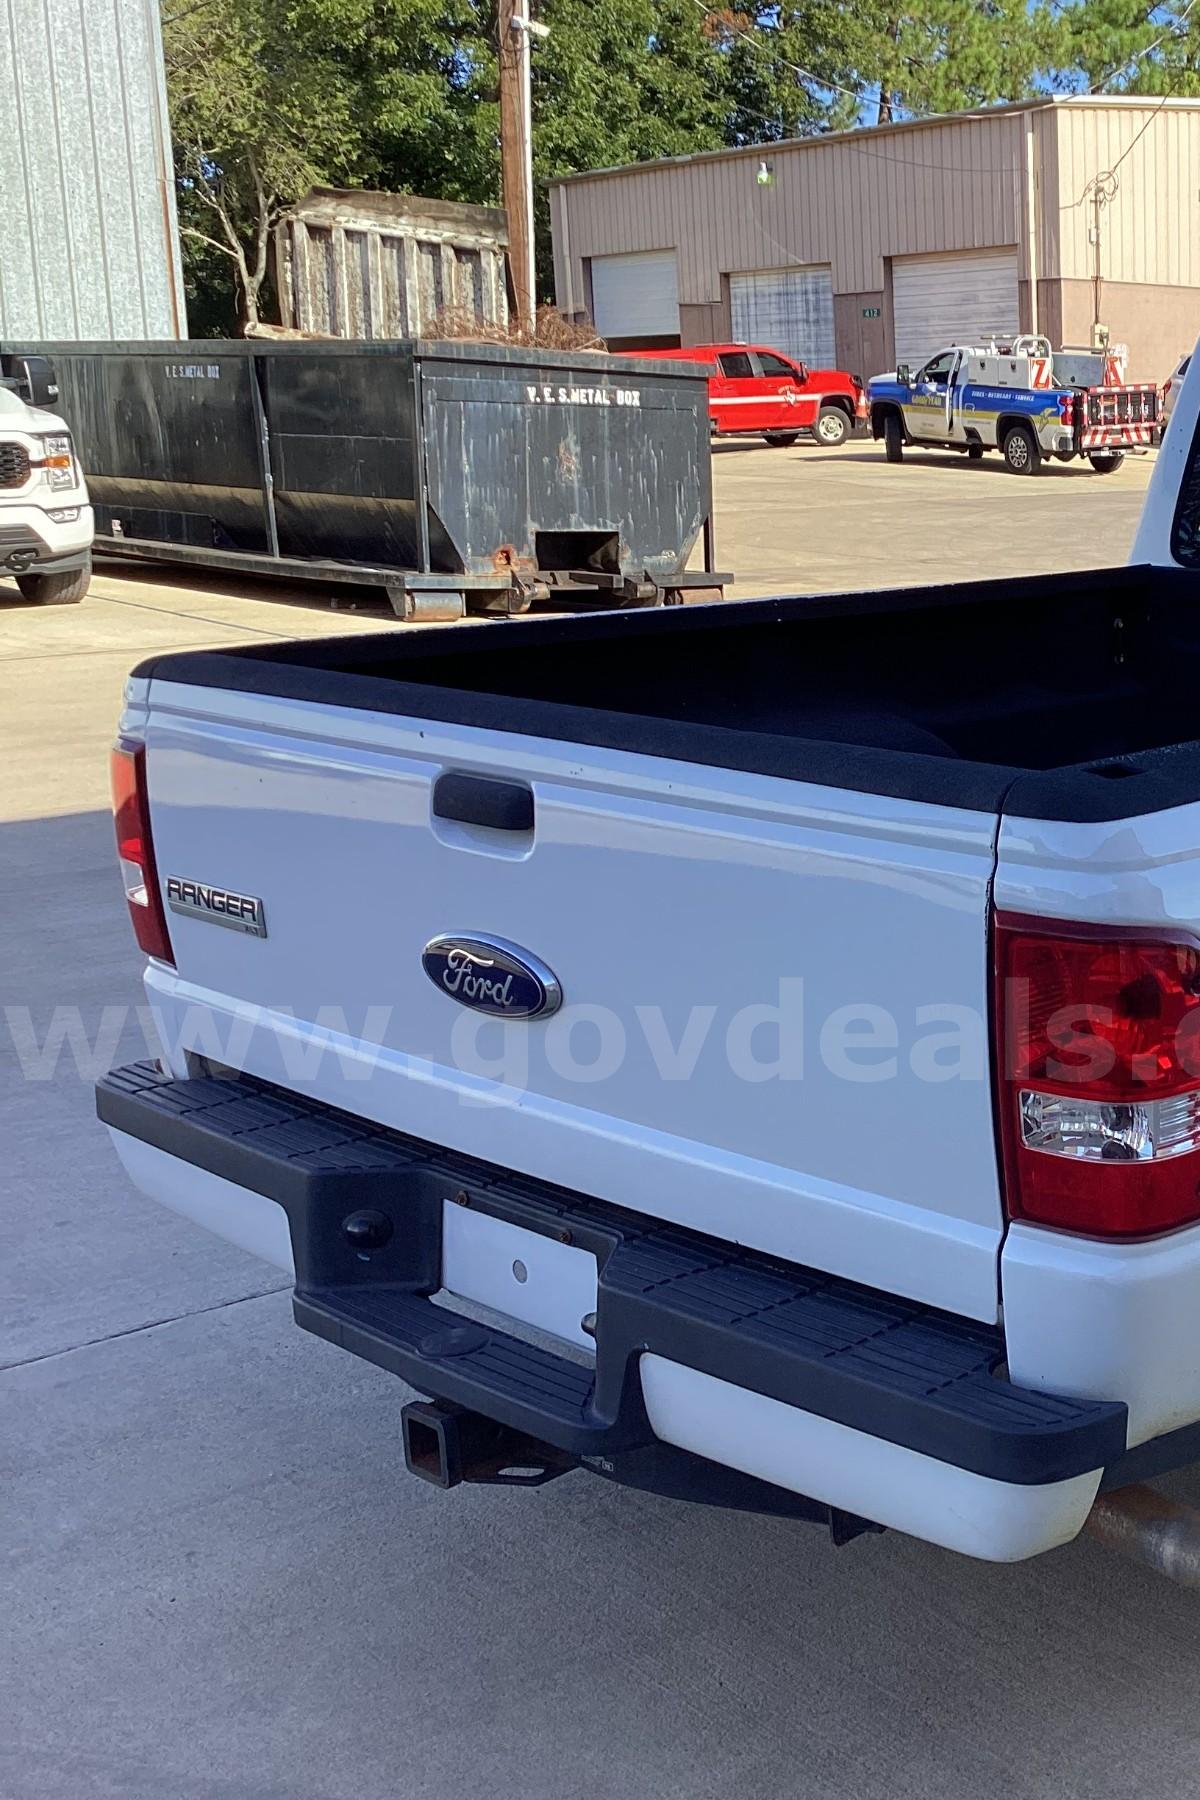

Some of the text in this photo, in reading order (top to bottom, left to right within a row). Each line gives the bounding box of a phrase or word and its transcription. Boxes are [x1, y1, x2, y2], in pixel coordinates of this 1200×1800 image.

[865, 309, 878, 317] 412
[616, 390, 640, 407] BOX
[167, 878, 257, 922] RANGER
[443, 949, 514, 1006] Ford
